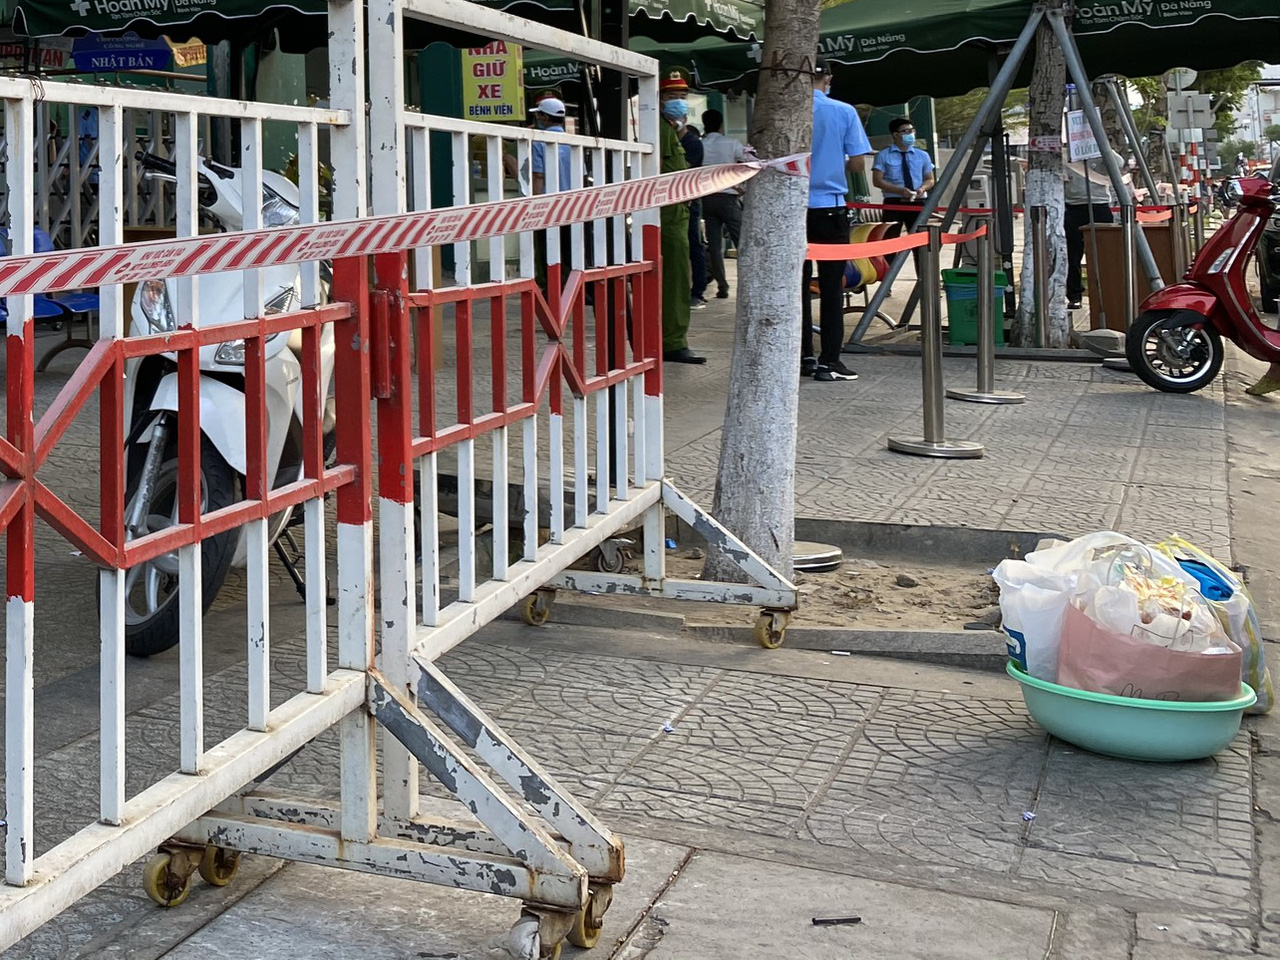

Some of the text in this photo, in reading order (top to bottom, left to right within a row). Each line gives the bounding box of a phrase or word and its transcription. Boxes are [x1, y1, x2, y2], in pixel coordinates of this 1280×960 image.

[1076, 2, 1120, 18] oàn
[825, 34, 855, 52] Mỹ
[91, 54, 125, 69] NHẬT
[472, 59, 507, 78] GIỮ
[477, 84, 502, 99] XE
[469, 102, 513, 118] BỆNH VIỆN
